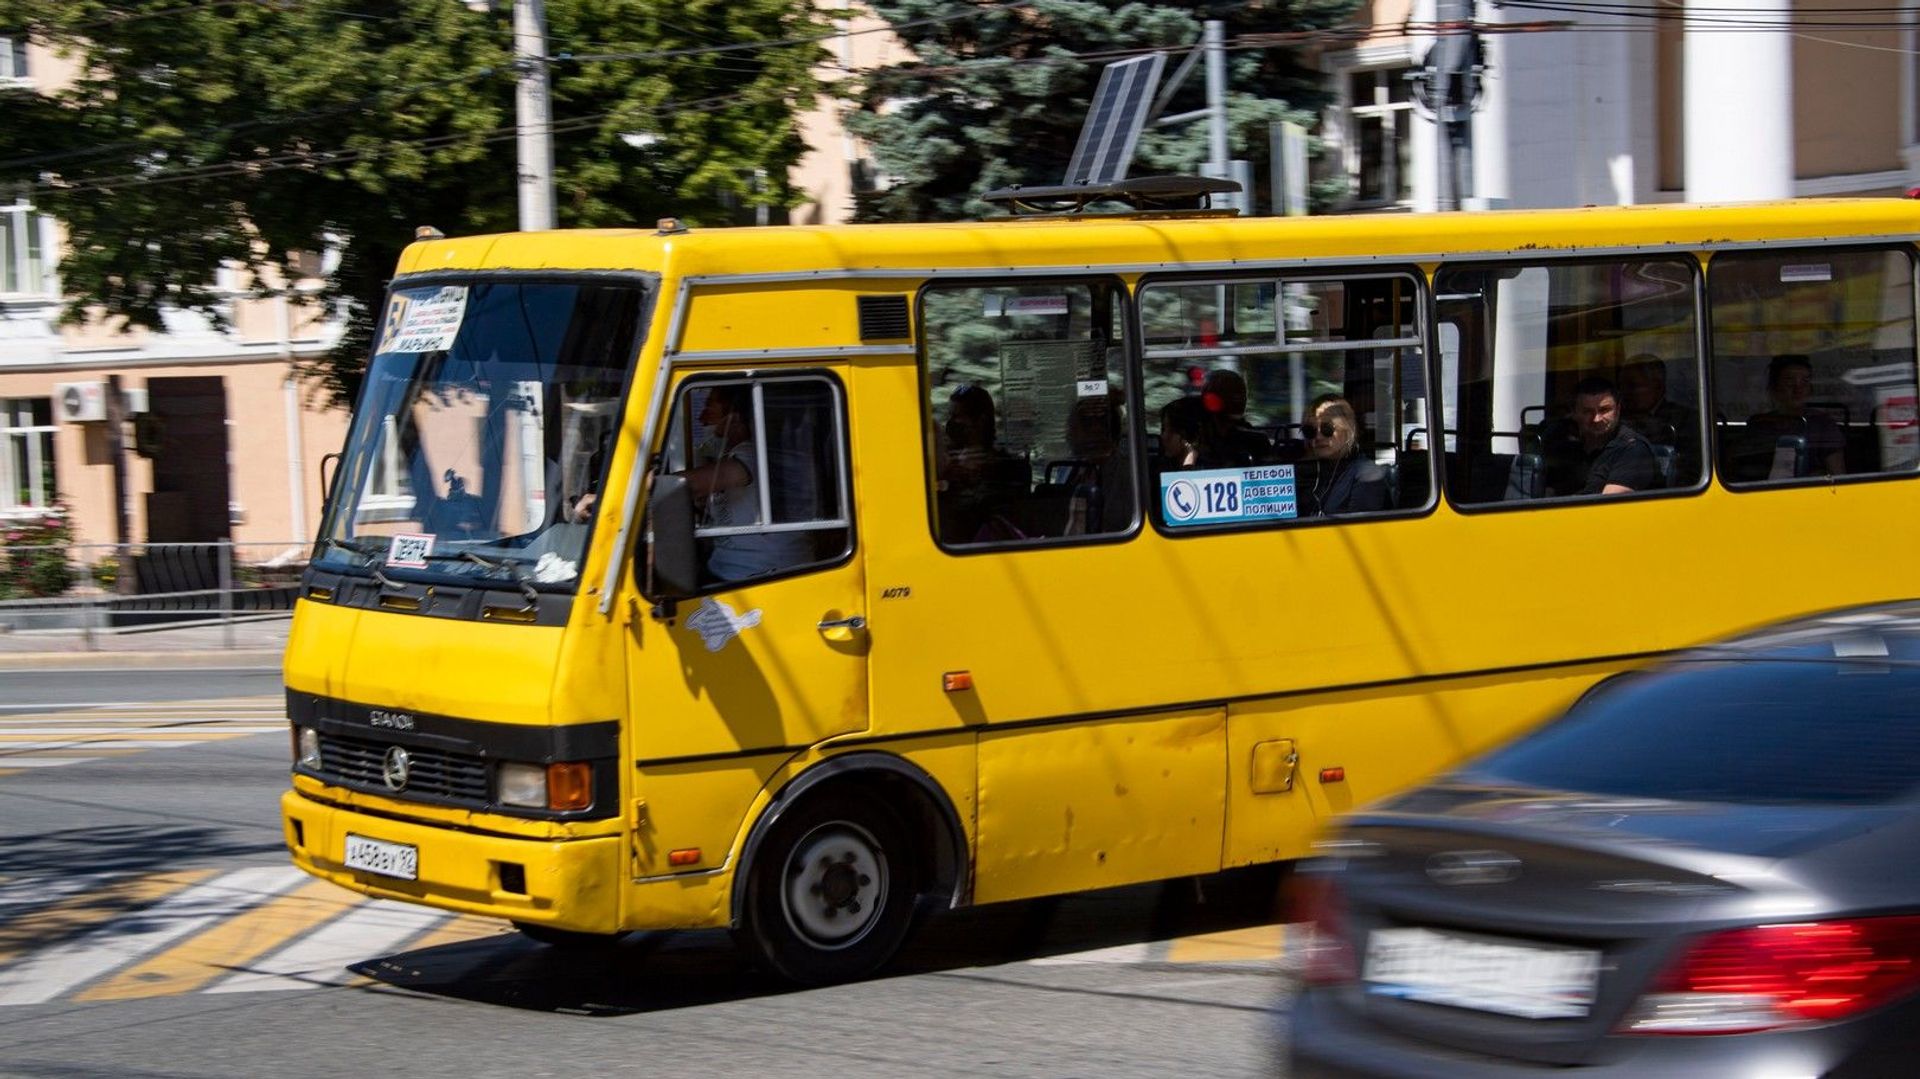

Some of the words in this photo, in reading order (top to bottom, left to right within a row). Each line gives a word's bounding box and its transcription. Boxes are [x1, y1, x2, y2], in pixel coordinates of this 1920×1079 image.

[1243, 468, 1292, 480] ТЕЛЕФОН
[1203, 481, 1239, 513] 128
[1244, 485, 1294, 499] ДОВЕРИЯ
[1245, 502, 1296, 516] ПОЛИЦИИ
